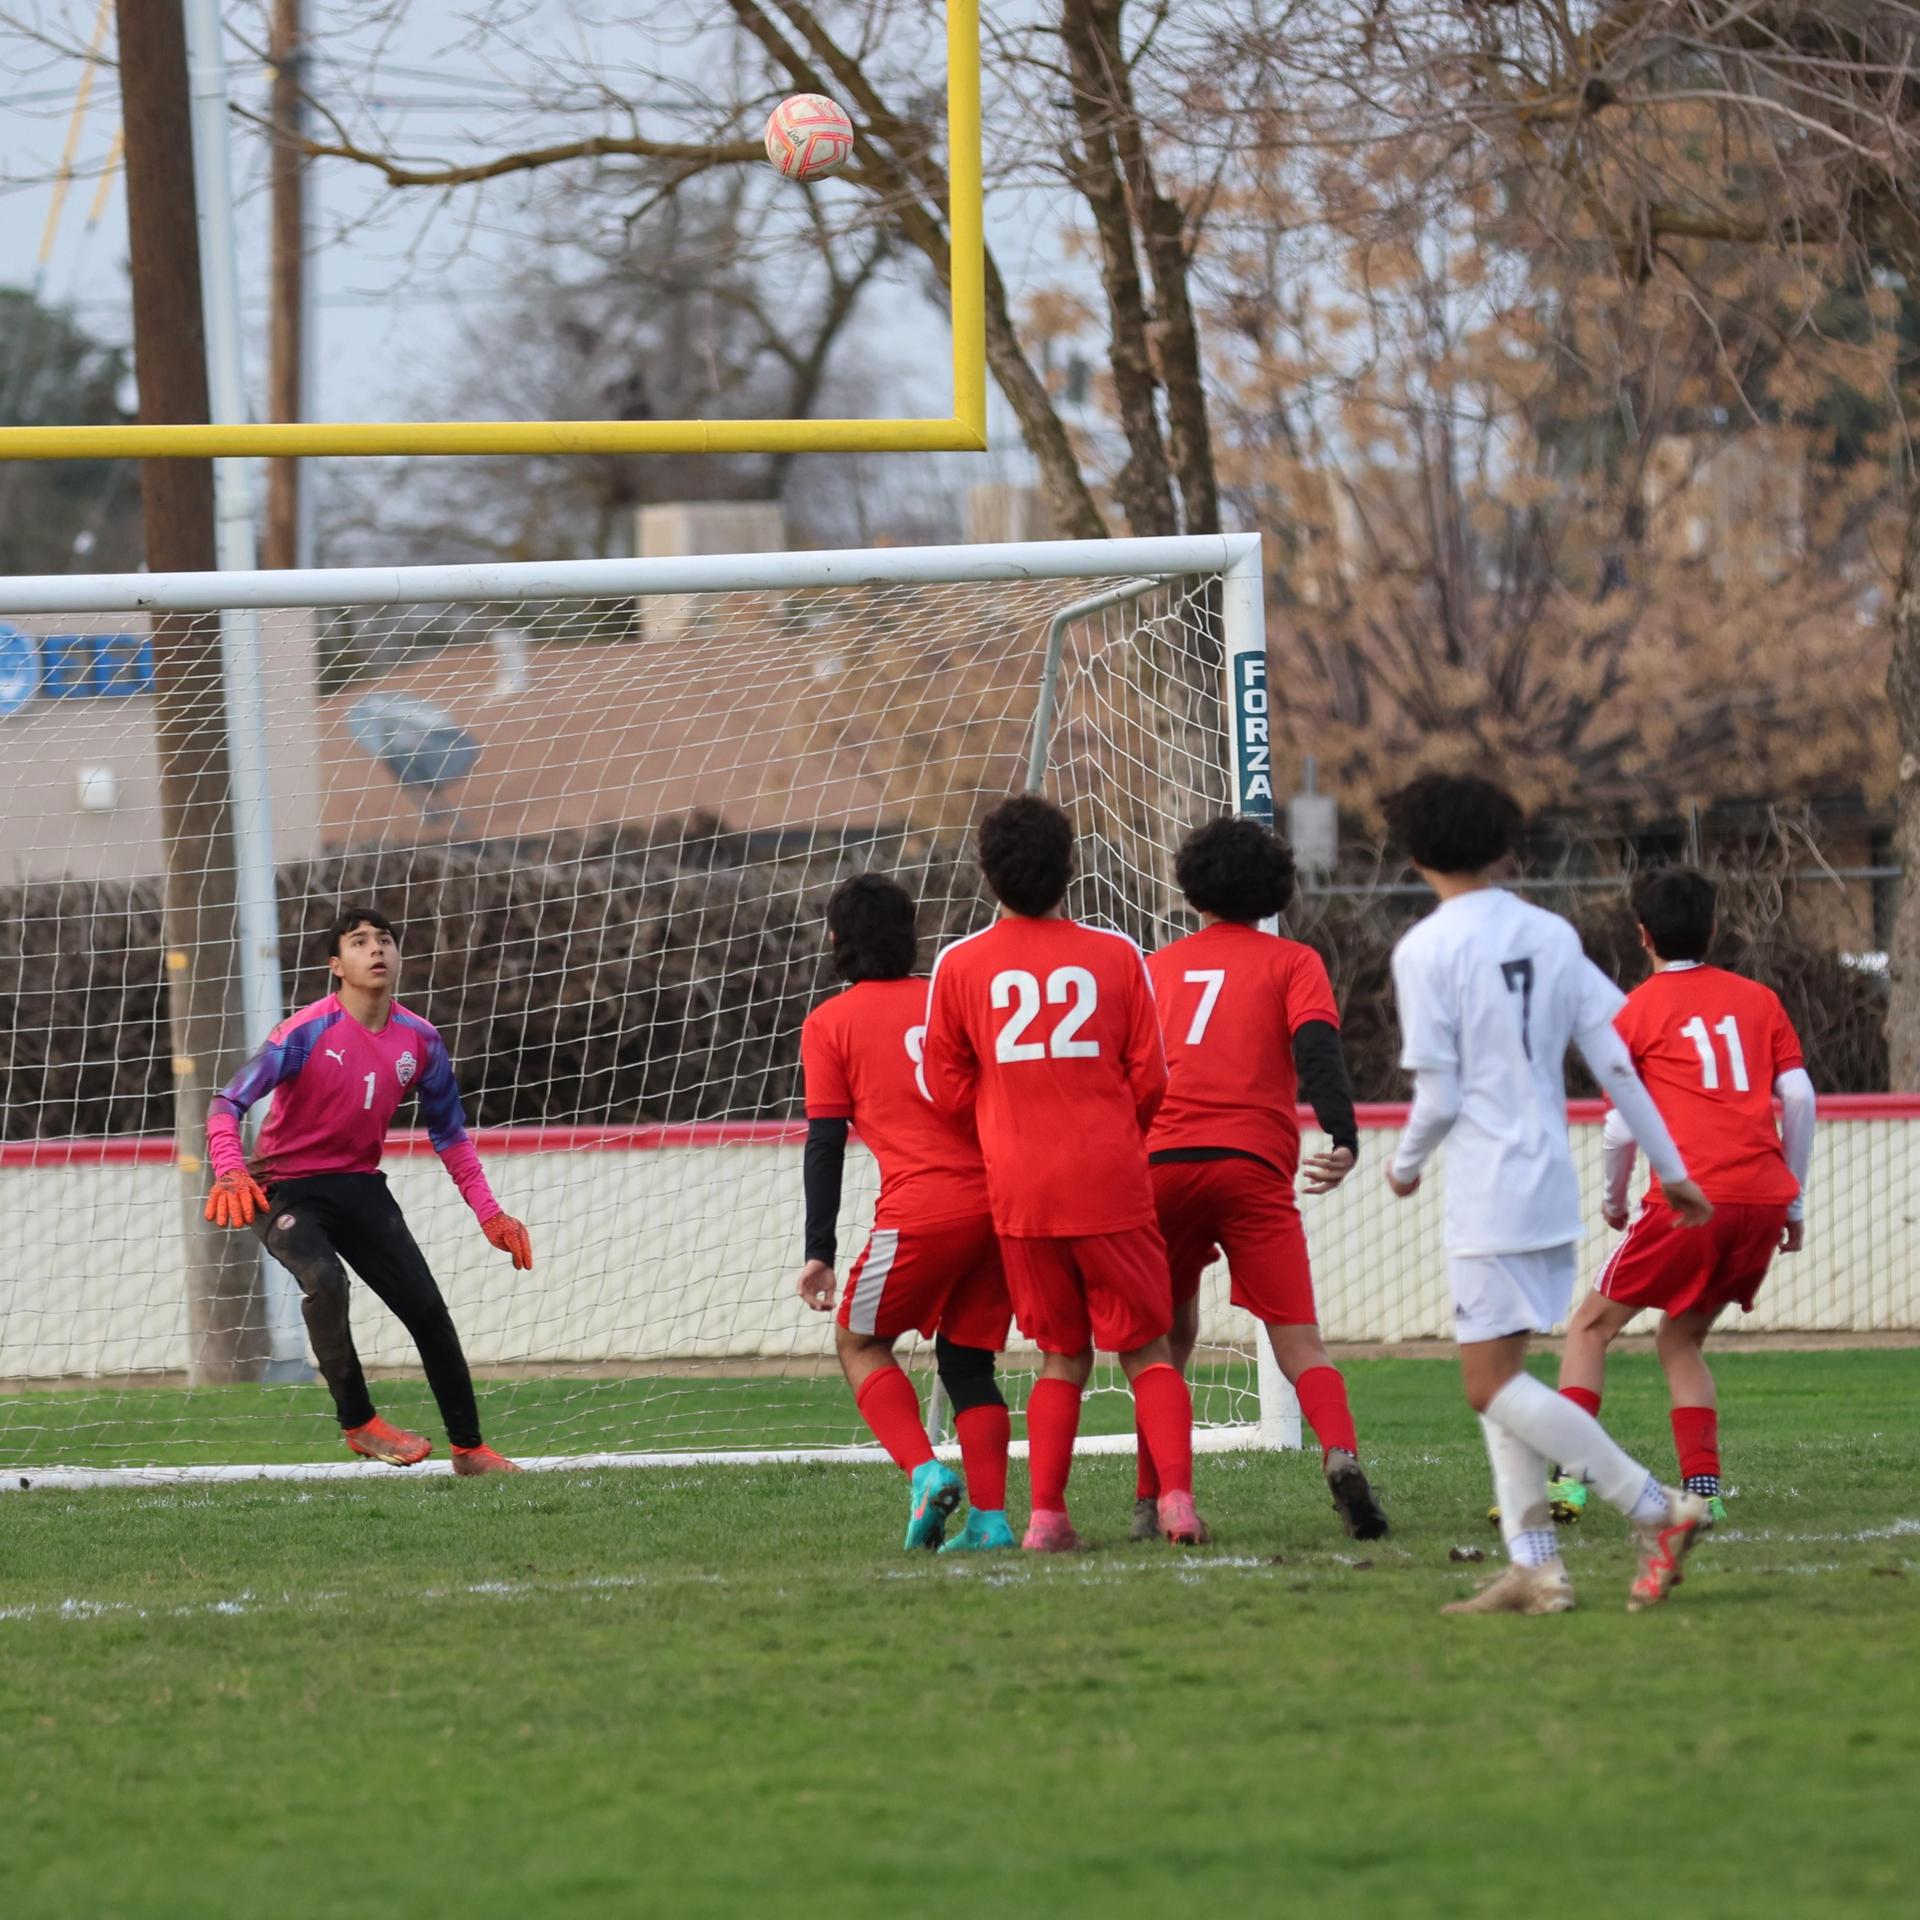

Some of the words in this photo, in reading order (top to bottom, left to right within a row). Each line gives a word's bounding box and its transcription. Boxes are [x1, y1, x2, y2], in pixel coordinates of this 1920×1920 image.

[1243, 660, 1272, 800] FORZA
[990, 965, 1100, 1064] 22
[1184, 969, 1226, 1045] 7
[1501, 958, 1534, 1062] 7
[363, 1071, 376, 1110] 1
[1680, 1015, 1750, 1092] 11
